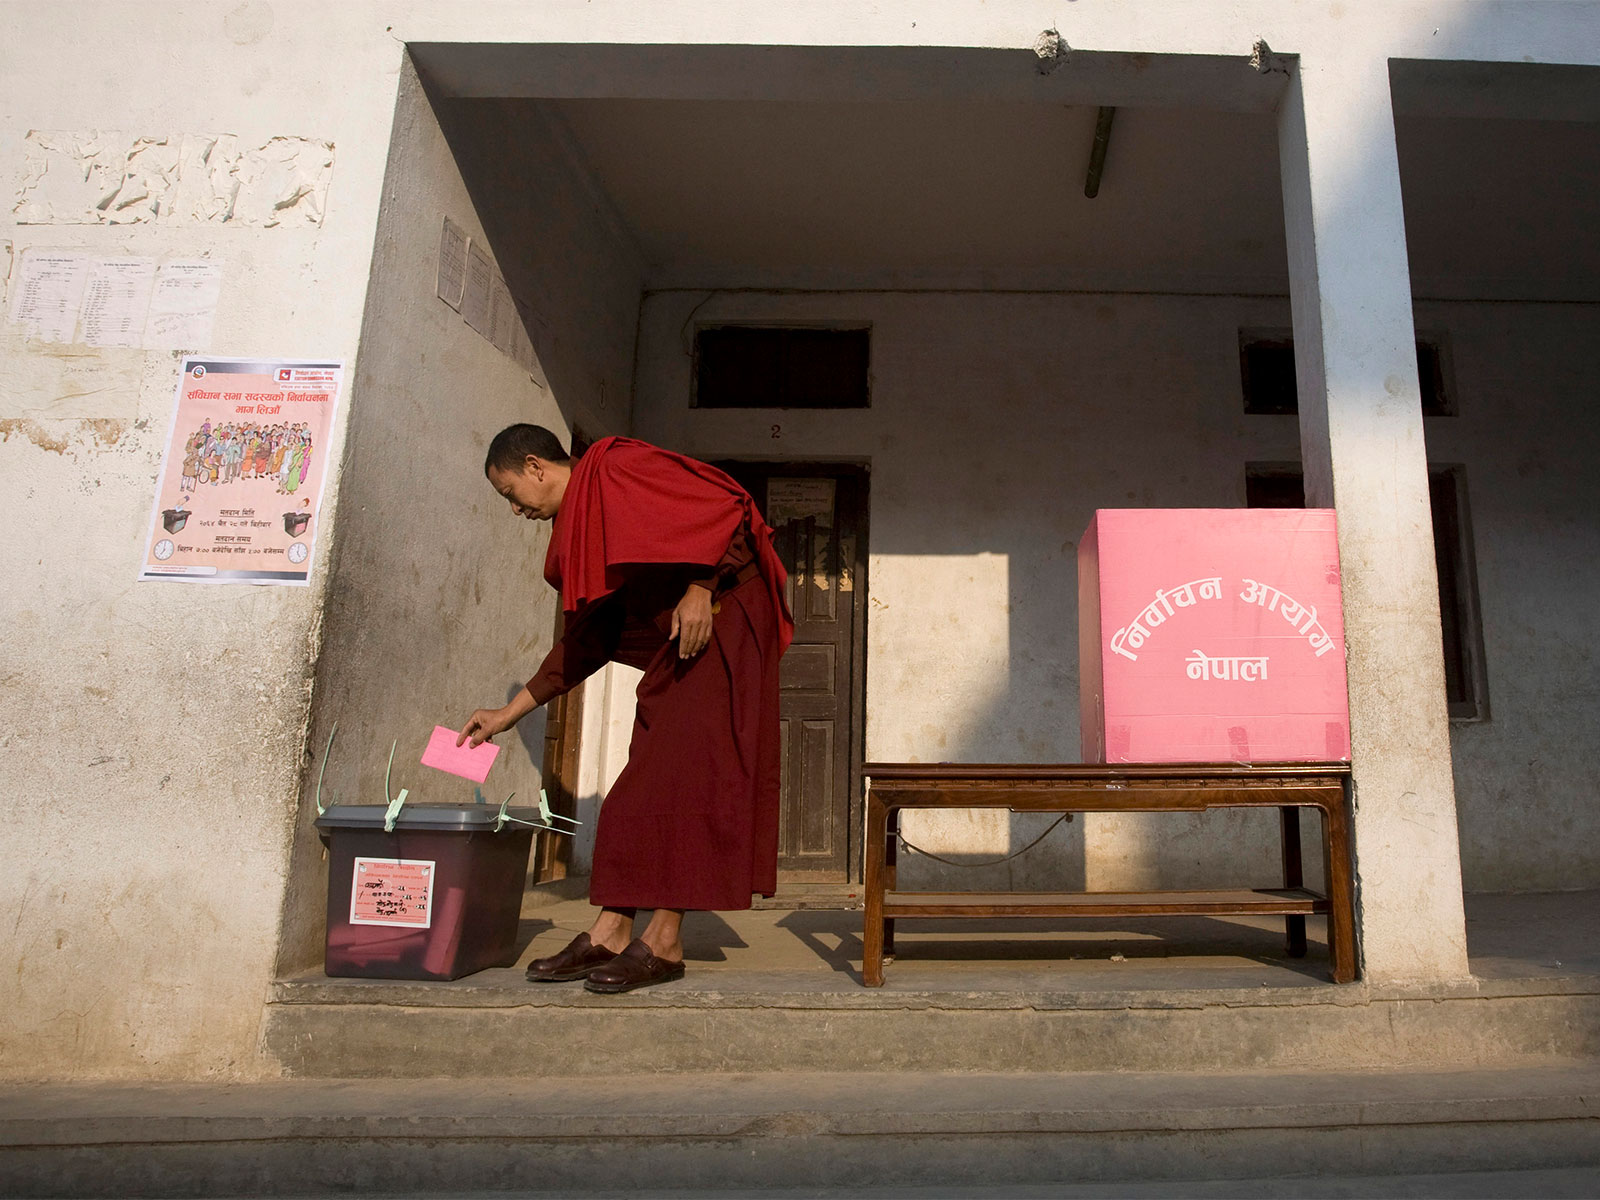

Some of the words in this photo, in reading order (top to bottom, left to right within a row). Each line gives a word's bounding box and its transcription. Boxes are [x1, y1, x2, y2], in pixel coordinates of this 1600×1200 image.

[187, 389, 221, 400] संविधान
[223, 392, 242, 400] सभा
[244, 391, 284, 402] सदस्यको
[235, 405, 255, 414] भाग
[771, 424, 781, 439] 2
[1110, 577, 1222, 661] निर्वाचन
[1240, 578, 1336, 657] आयोग
[1185, 649, 1269, 681] नेपाल
